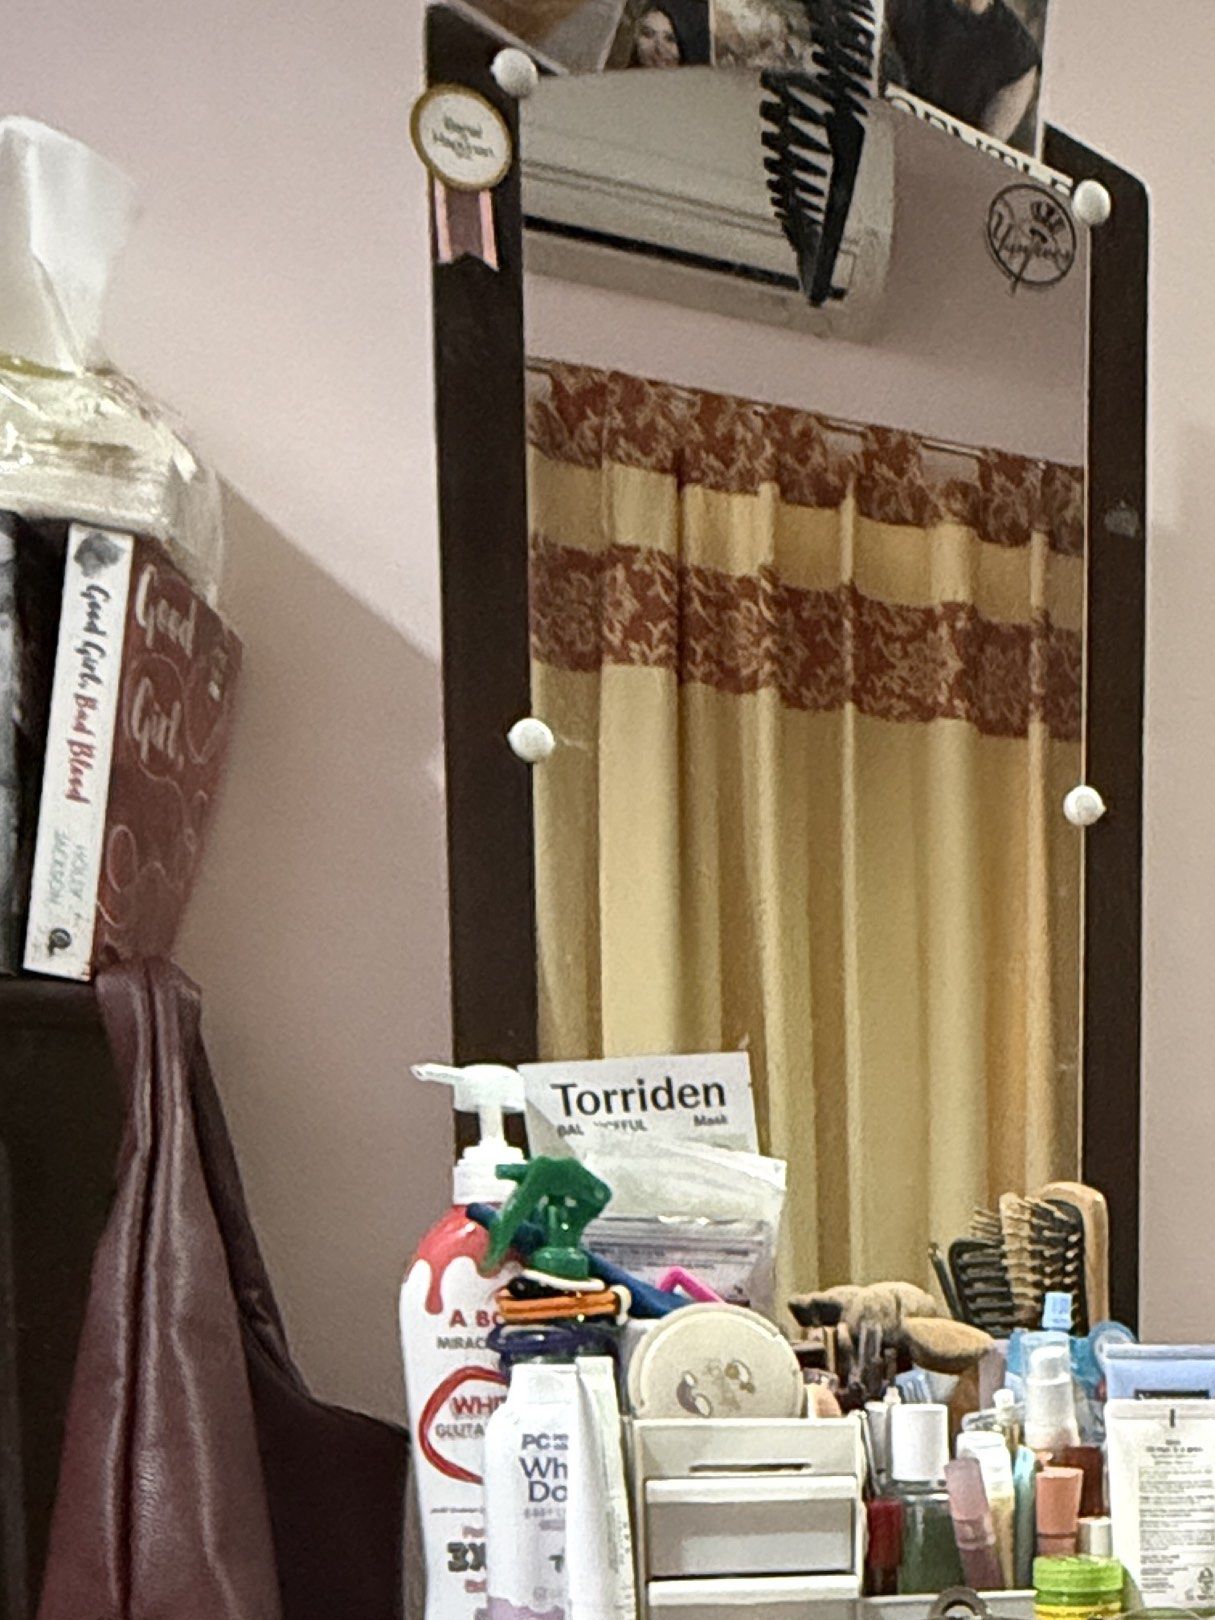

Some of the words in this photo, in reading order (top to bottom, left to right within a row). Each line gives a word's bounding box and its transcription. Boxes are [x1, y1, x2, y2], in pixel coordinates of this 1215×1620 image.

[80, 584, 110, 636] Good
[135, 562, 198, 659] Good
[73, 692, 98, 736] Bad
[65, 739, 97, 804] Blood
[550, 1076, 726, 1117] Torriden
[449, 1309, 468, 1328] A
